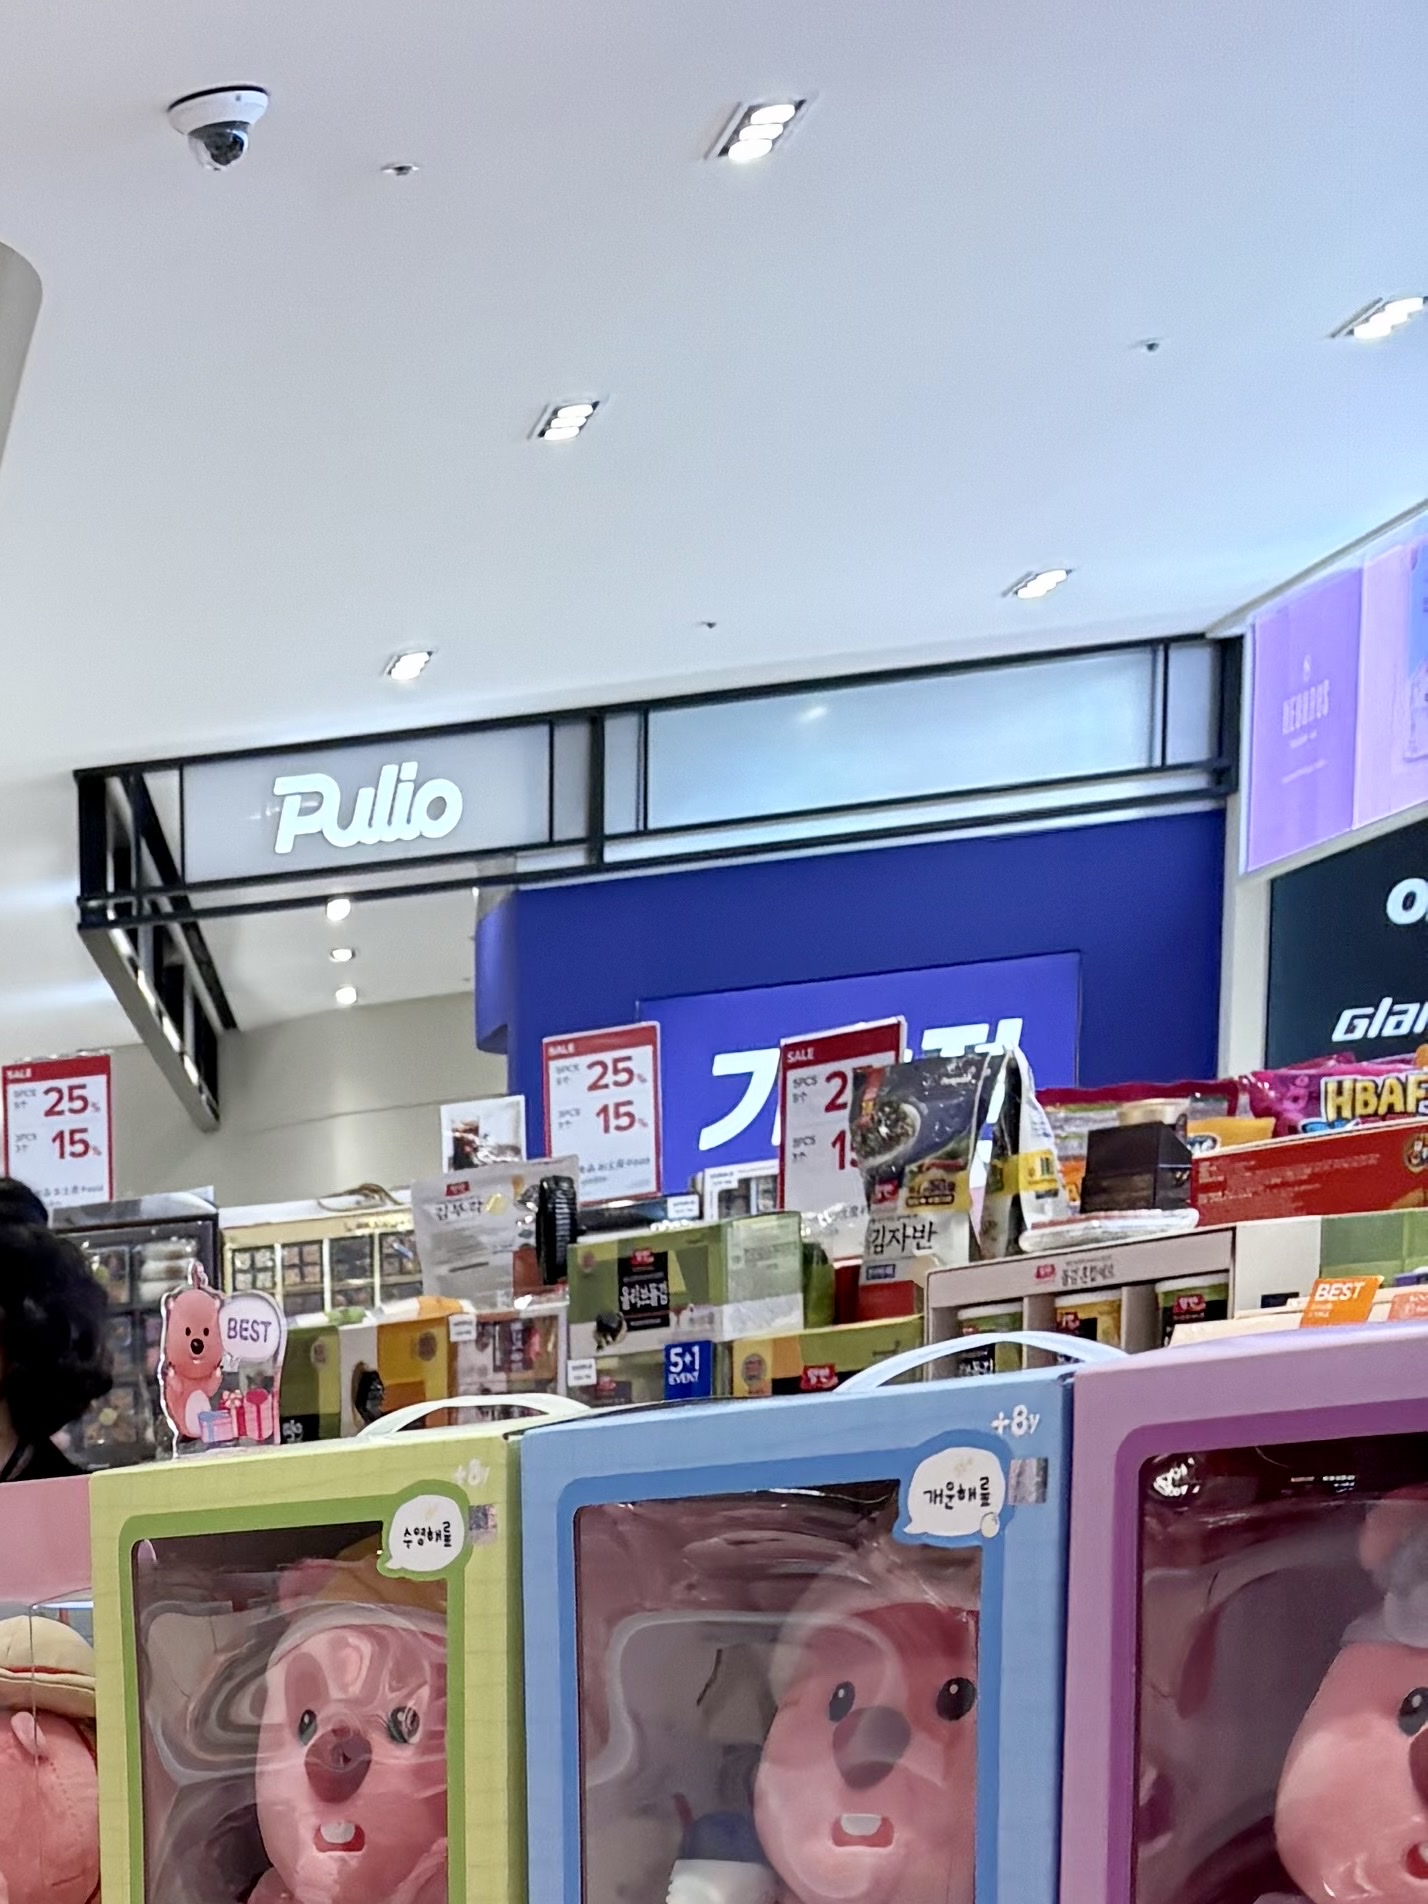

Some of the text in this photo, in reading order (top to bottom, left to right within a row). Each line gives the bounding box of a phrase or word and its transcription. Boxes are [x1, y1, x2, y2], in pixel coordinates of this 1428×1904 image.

[272, 762, 463, 854] Pulio
[787, 1047, 815, 1063] SALE
[870, 1220, 939, 1255] 김자반
[1315, 1280, 1365, 1301] BEST
[227, 1317, 272, 1344] BEST
[669, 1340, 700, 1374] 5+1
[669, 1371, 699, 1387] EVENT
[991, 1404, 1040, 1437] +8y
